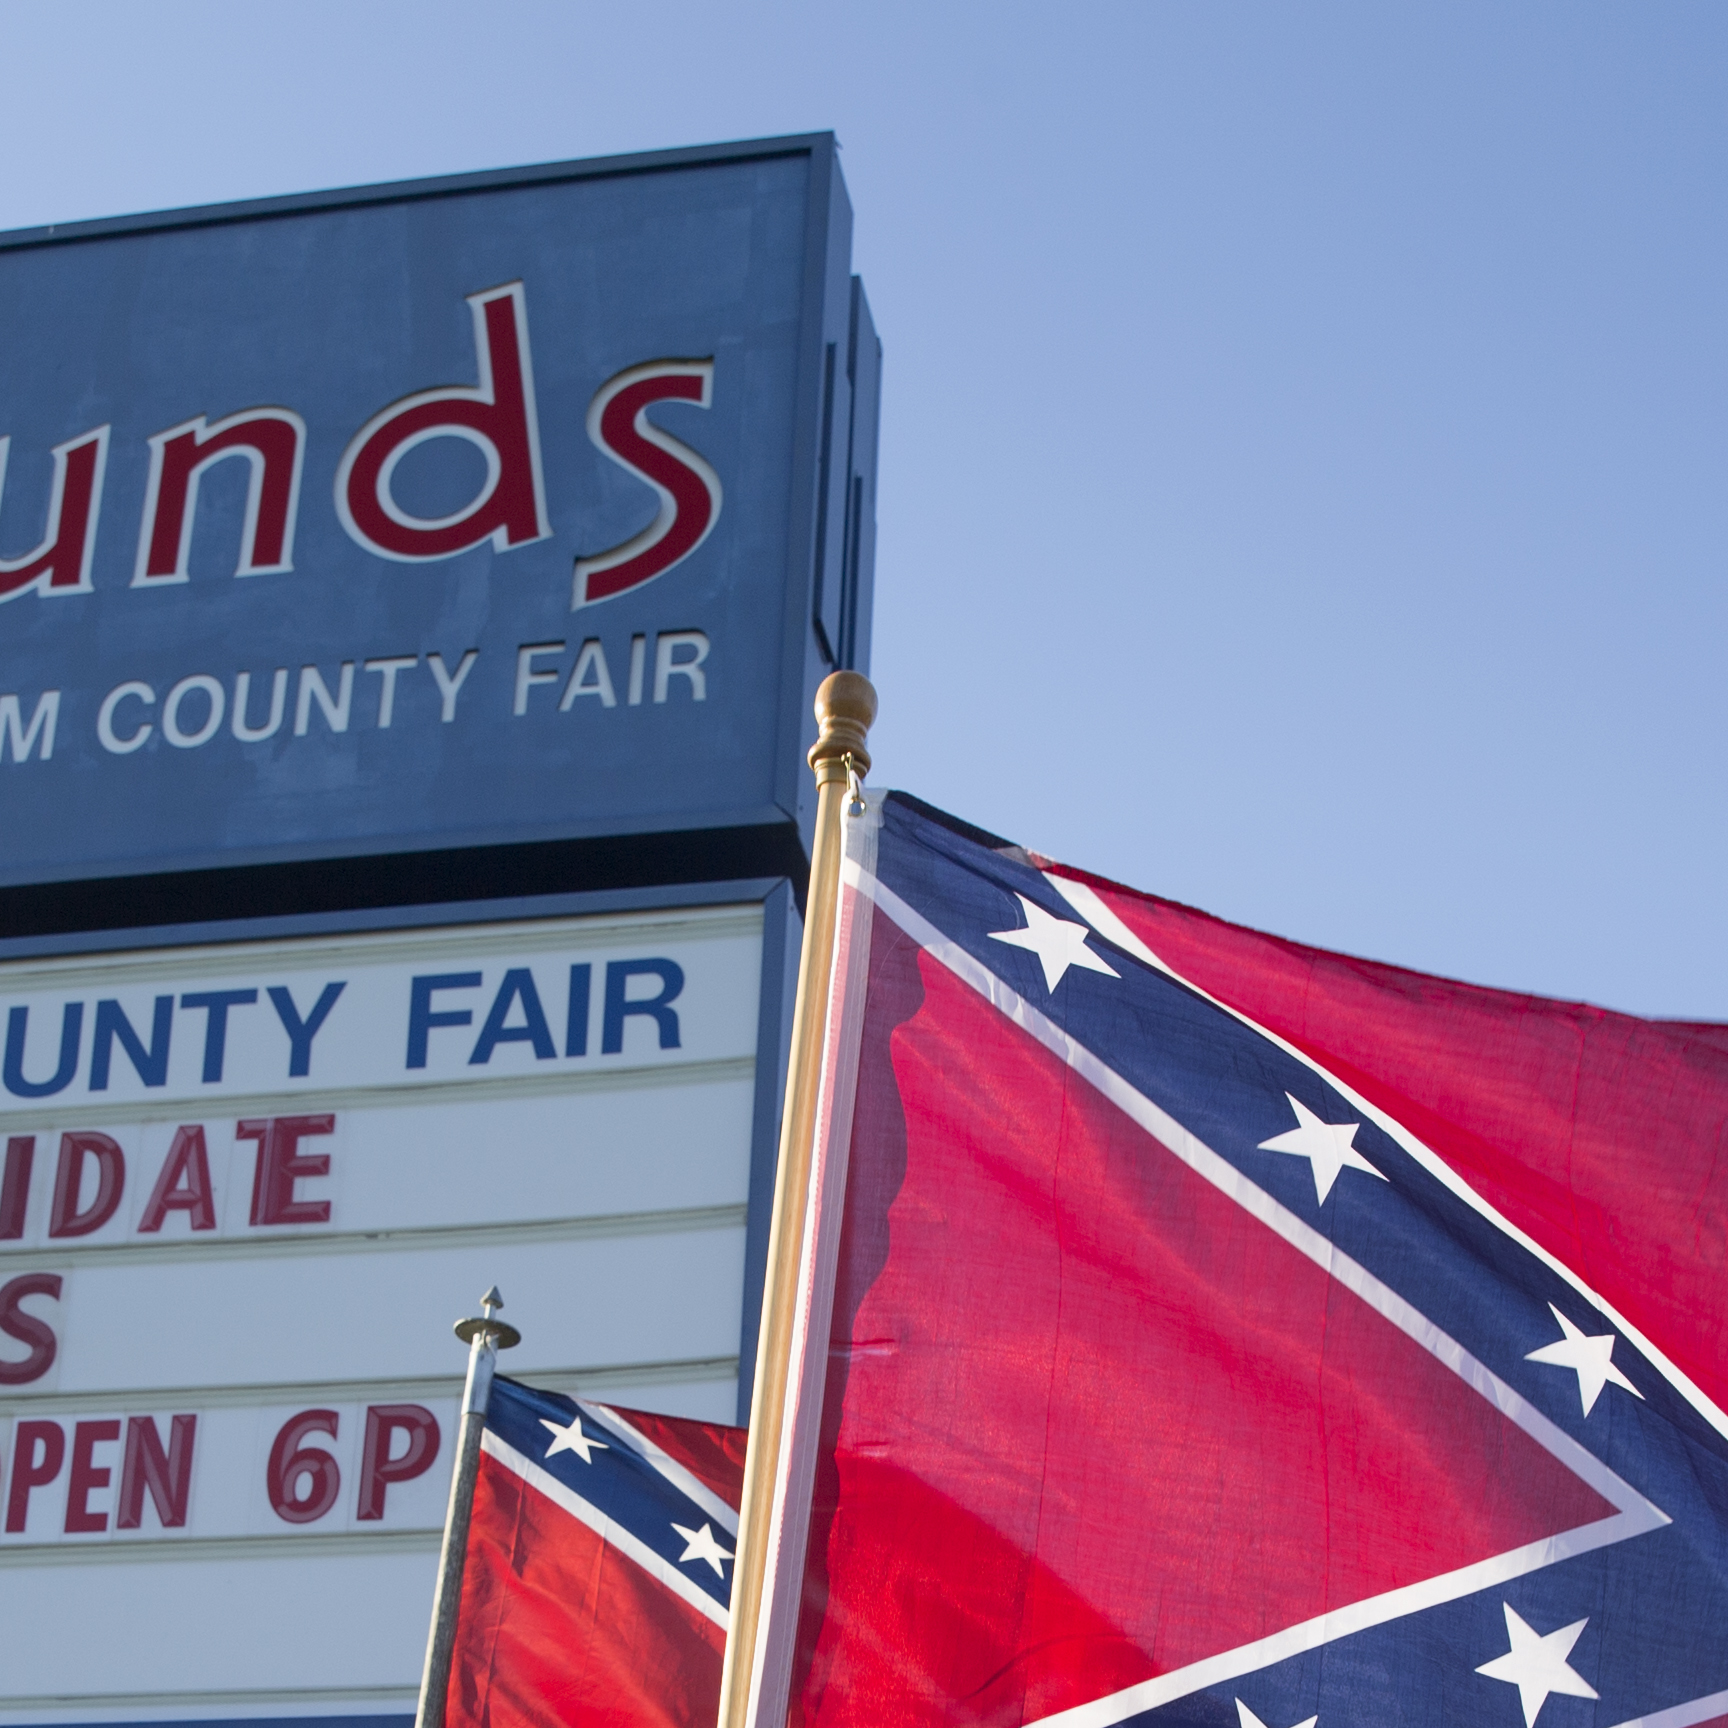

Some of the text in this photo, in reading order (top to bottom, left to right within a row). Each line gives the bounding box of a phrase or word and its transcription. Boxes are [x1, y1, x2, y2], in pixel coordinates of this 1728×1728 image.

[96, 649, 478, 755] COUNTY
[513, 630, 711, 717] FAIR
[404, 956, 687, 1071] FAIR
